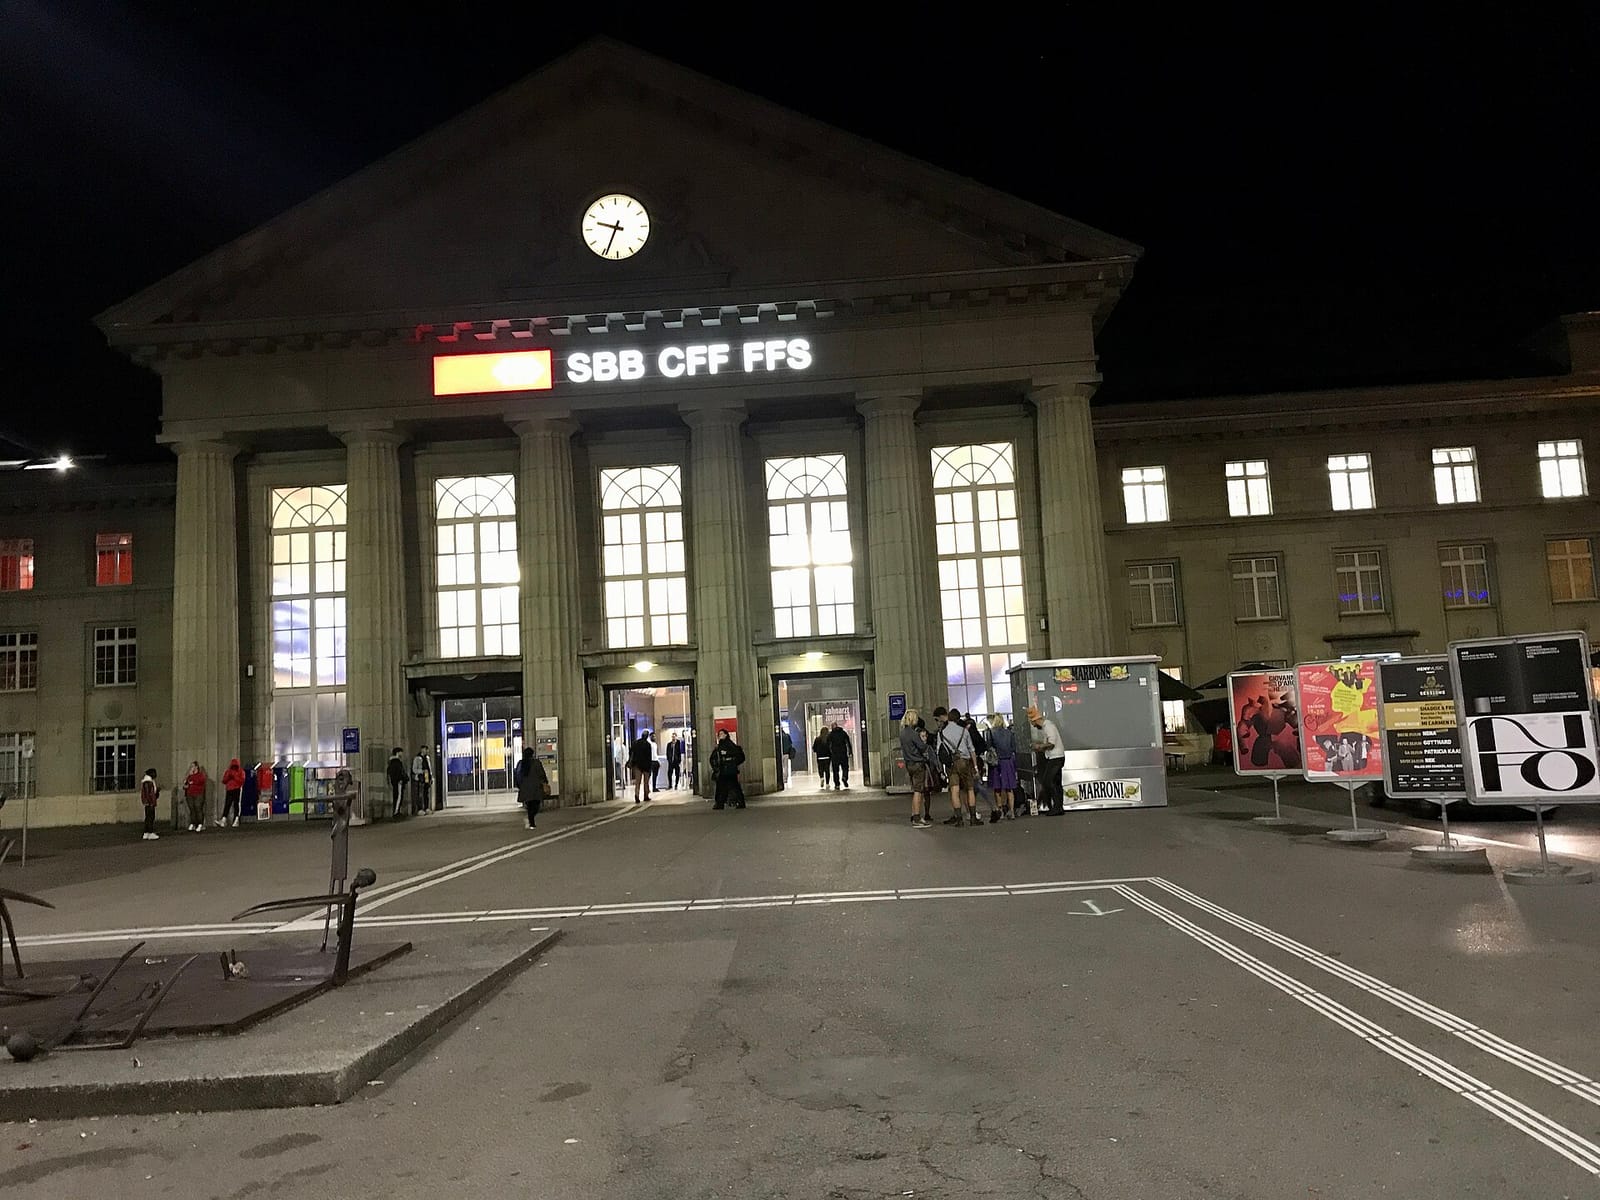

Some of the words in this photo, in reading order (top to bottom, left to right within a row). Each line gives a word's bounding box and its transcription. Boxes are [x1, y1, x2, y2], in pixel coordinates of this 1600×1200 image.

[566, 350, 645, 383] SBB
[658, 343, 729, 378] CFF
[742, 338, 813, 372] FFS
[1072, 665, 1111, 680] MARRONS
